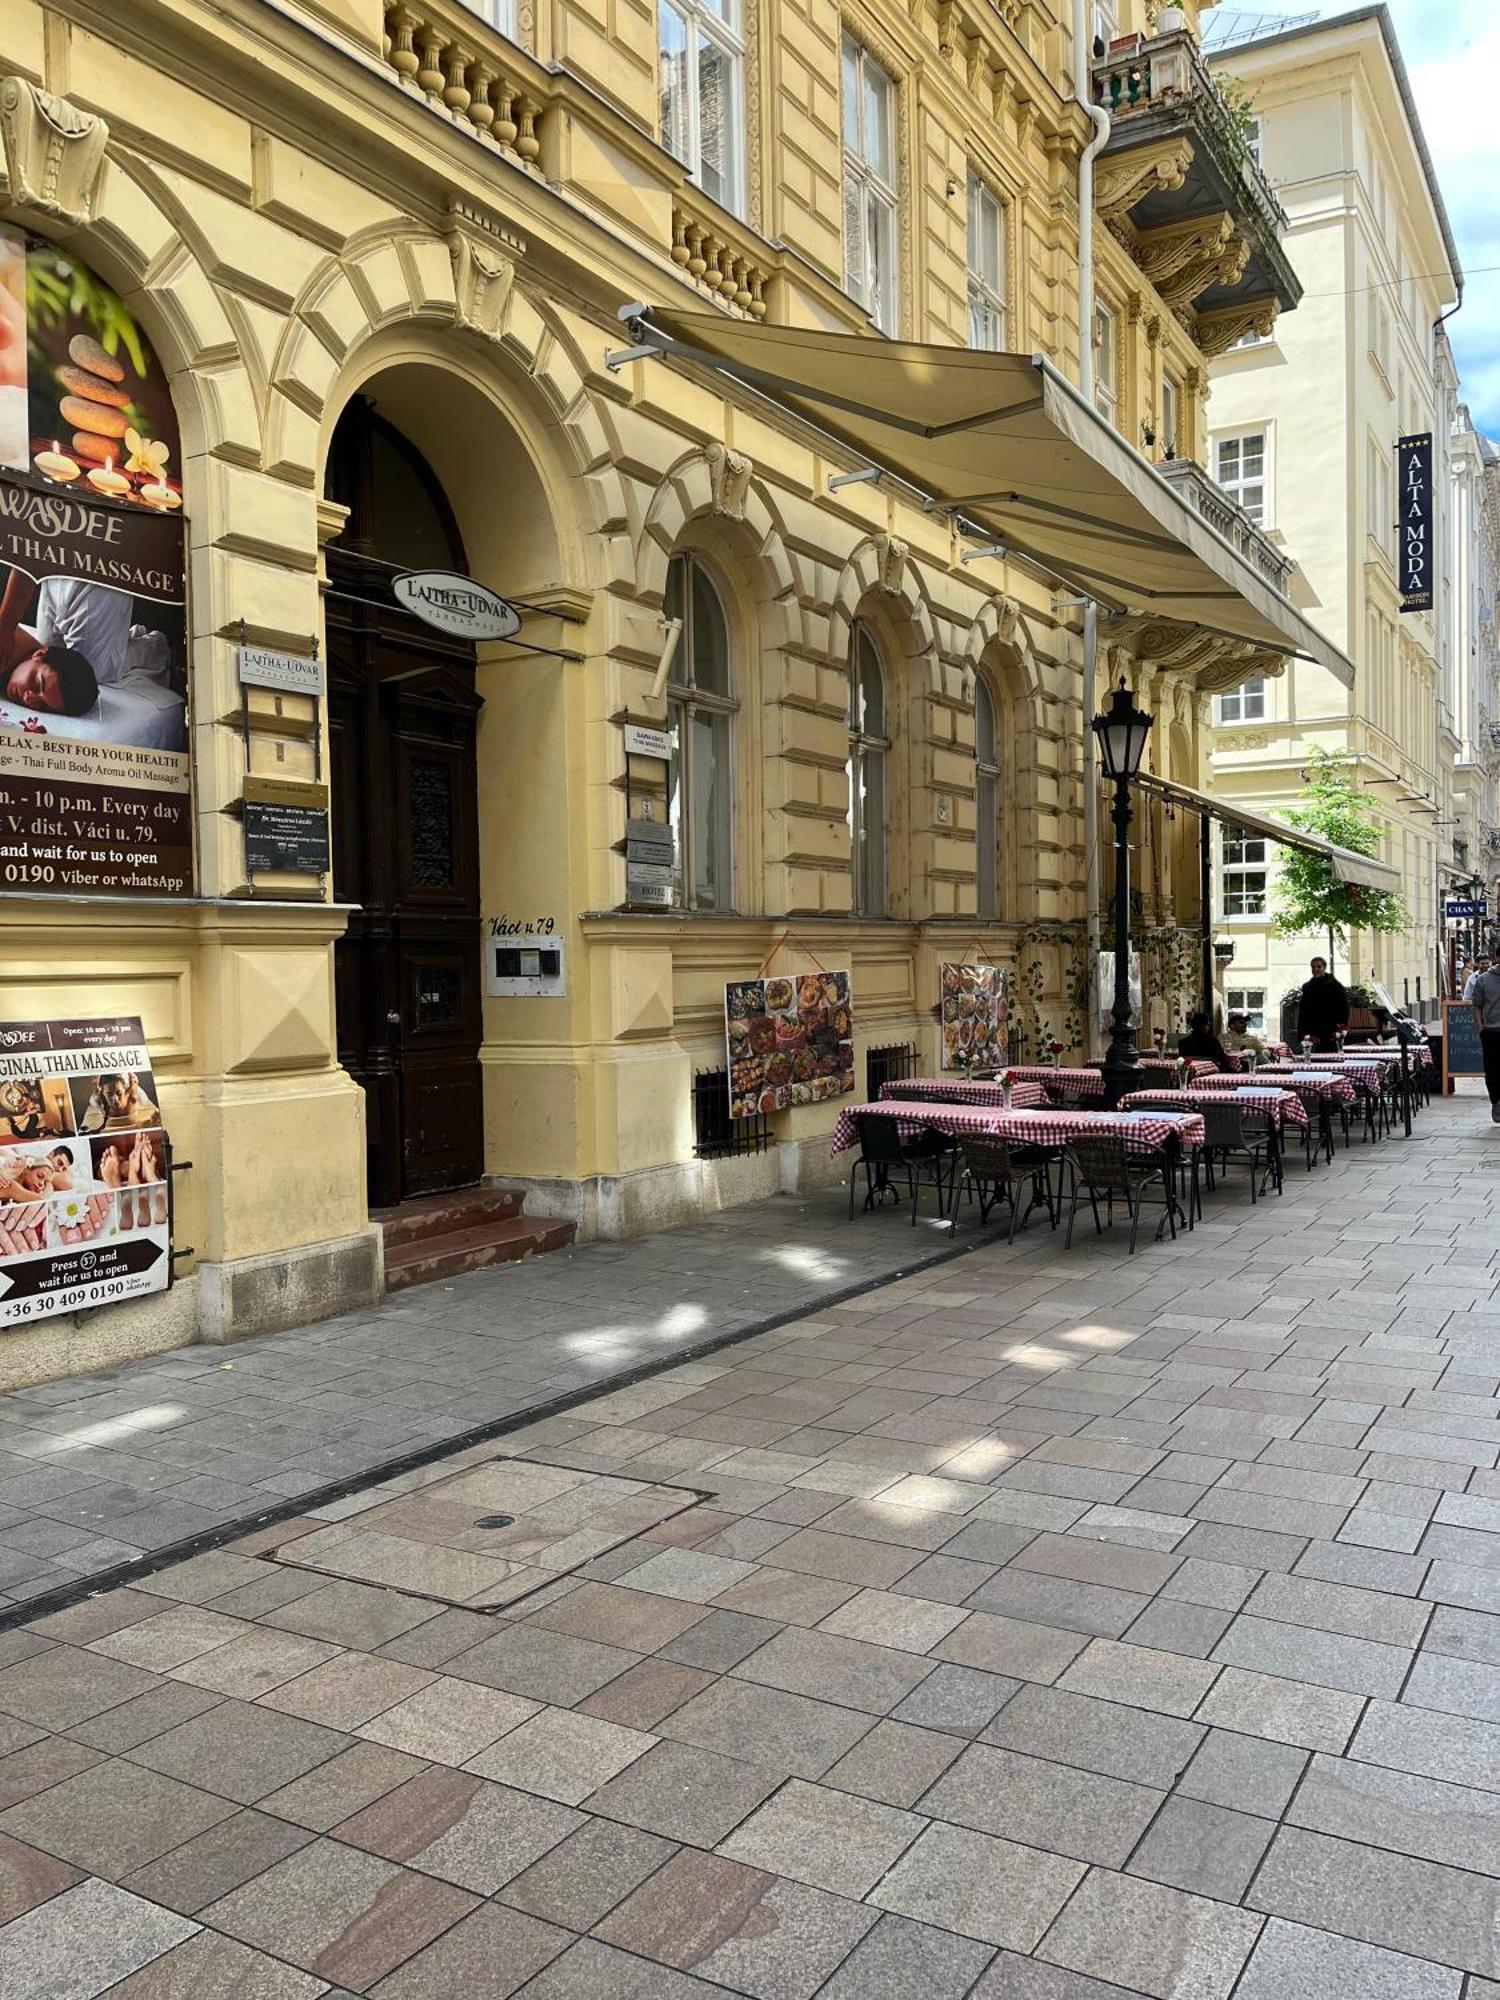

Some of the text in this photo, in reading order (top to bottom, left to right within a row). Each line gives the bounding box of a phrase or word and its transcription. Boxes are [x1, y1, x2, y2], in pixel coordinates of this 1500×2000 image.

[1406, 453, 1425, 589] ALTA MODA
[8, 534, 175, 592] THAI MASSAGE
[43, 742, 73, 754] BEST
[75, 746, 99, 757] FOR
[102, 749, 133, 762] YOUR
[136, 754, 178, 767] HEALTH
[22, 756, 44, 768] Thai
[47, 759, 66, 770] Full
[69, 763, 92, 775] Body
[96, 767, 125, 777] Aroma
[128, 767, 141, 778] Oil
[143, 771, 179, 784] Massage
[35, 791, 54, 808] 10
[60, 797, 97, 814] p.m.
[103, 797, 148, 820] Every
[154, 803, 181, 823] day
[8, 816, 25, 833] V.
[31, 818, 67, 836] dist.
[73, 820, 111, 840] Váci
[115, 828, 130, 841] u.
[135, 826, 158, 843] 79.
[0, 842, 158, 867] and wait for us to open
[5, 864, 184, 890] 0190 Viber or whatsApp
[1449, 905, 1487, 913] CHANE
[488, 915, 521, 936] Váci
[537, 917, 555, 935] 79
[0, 1050, 142, 1076] GINAL THAI MASSAGE
[51, 1250, 117, 1273] Press 37 and
[38, 1263, 128, 1289] wait for us to open
[4, 1281, 124, 1317] +36 30 409 0190
